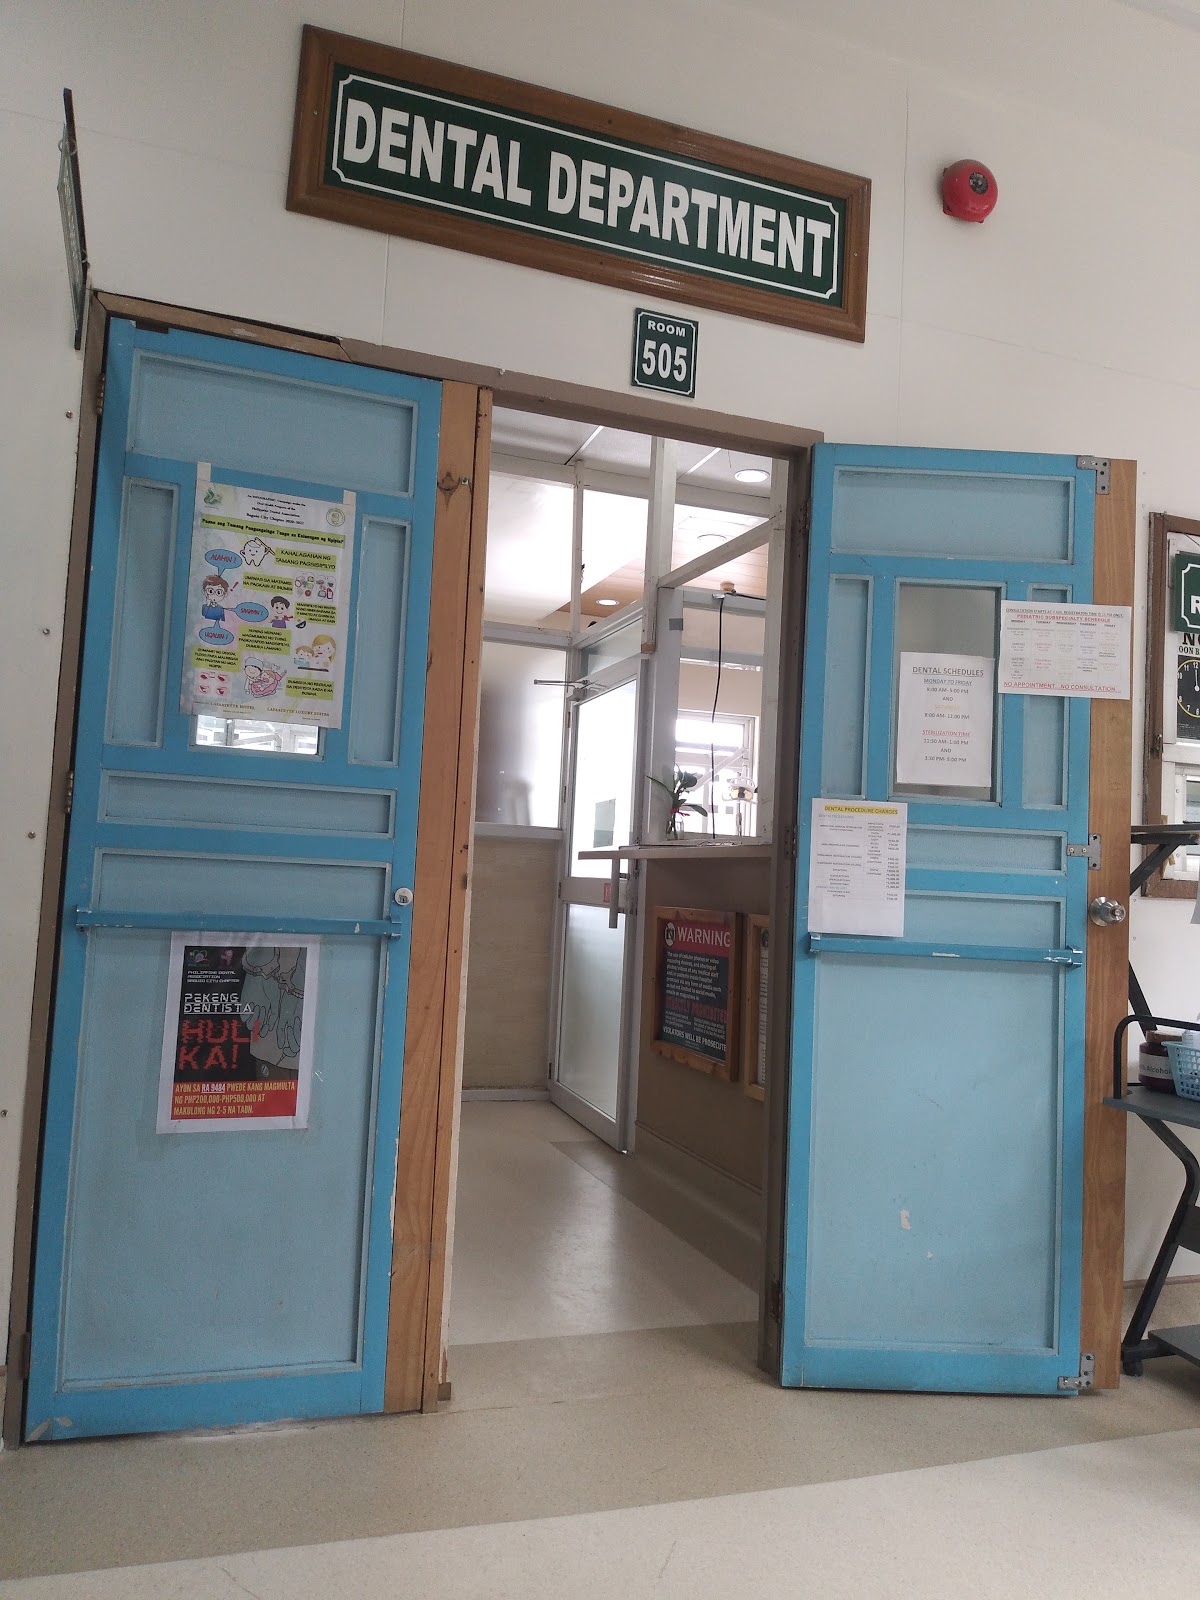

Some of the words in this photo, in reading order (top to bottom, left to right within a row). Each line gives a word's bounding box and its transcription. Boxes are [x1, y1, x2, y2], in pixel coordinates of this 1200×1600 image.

[343, 98, 532, 207] DENTAL
[547, 151, 831, 277] DEPARTMENT
[647, 319, 686, 338] ROOM
[642, 339, 687, 383] 505
[1182, 632, 1200, 646] N
[912, 667, 941, 675] DENTAL
[944, 668, 984, 677] SCHEDULES
[677, 926, 730, 948] WARNING
[184, 993, 239, 1002] PEKENG
[184, 1003, 252, 1013] DENTISTA
[181, 1017, 260, 1044] HULI
[663, 1026, 684, 1038] VIOLATORS
[685, 1032, 695, 1042] WILL
[696, 1036, 701, 1044] BE
[178, 1044, 238, 1070] KA!
[175, 1084, 191, 1093] AYON
[202, 1084, 210, 1092] RA
[226, 1083, 246, 1091] PWEDE
[247, 1083, 263, 1091] KANG
[264, 1082, 295, 1091] MAGMULTA
[175, 1096, 183, 1104] NG
[257, 1093, 265, 1102] AT
[173, 1107, 205, 1115] MAKULONG
[206, 1106, 216, 1115] NG
[216, 1106, 226, 1114] 2-5
[227, 1106, 236, 1114] NA
